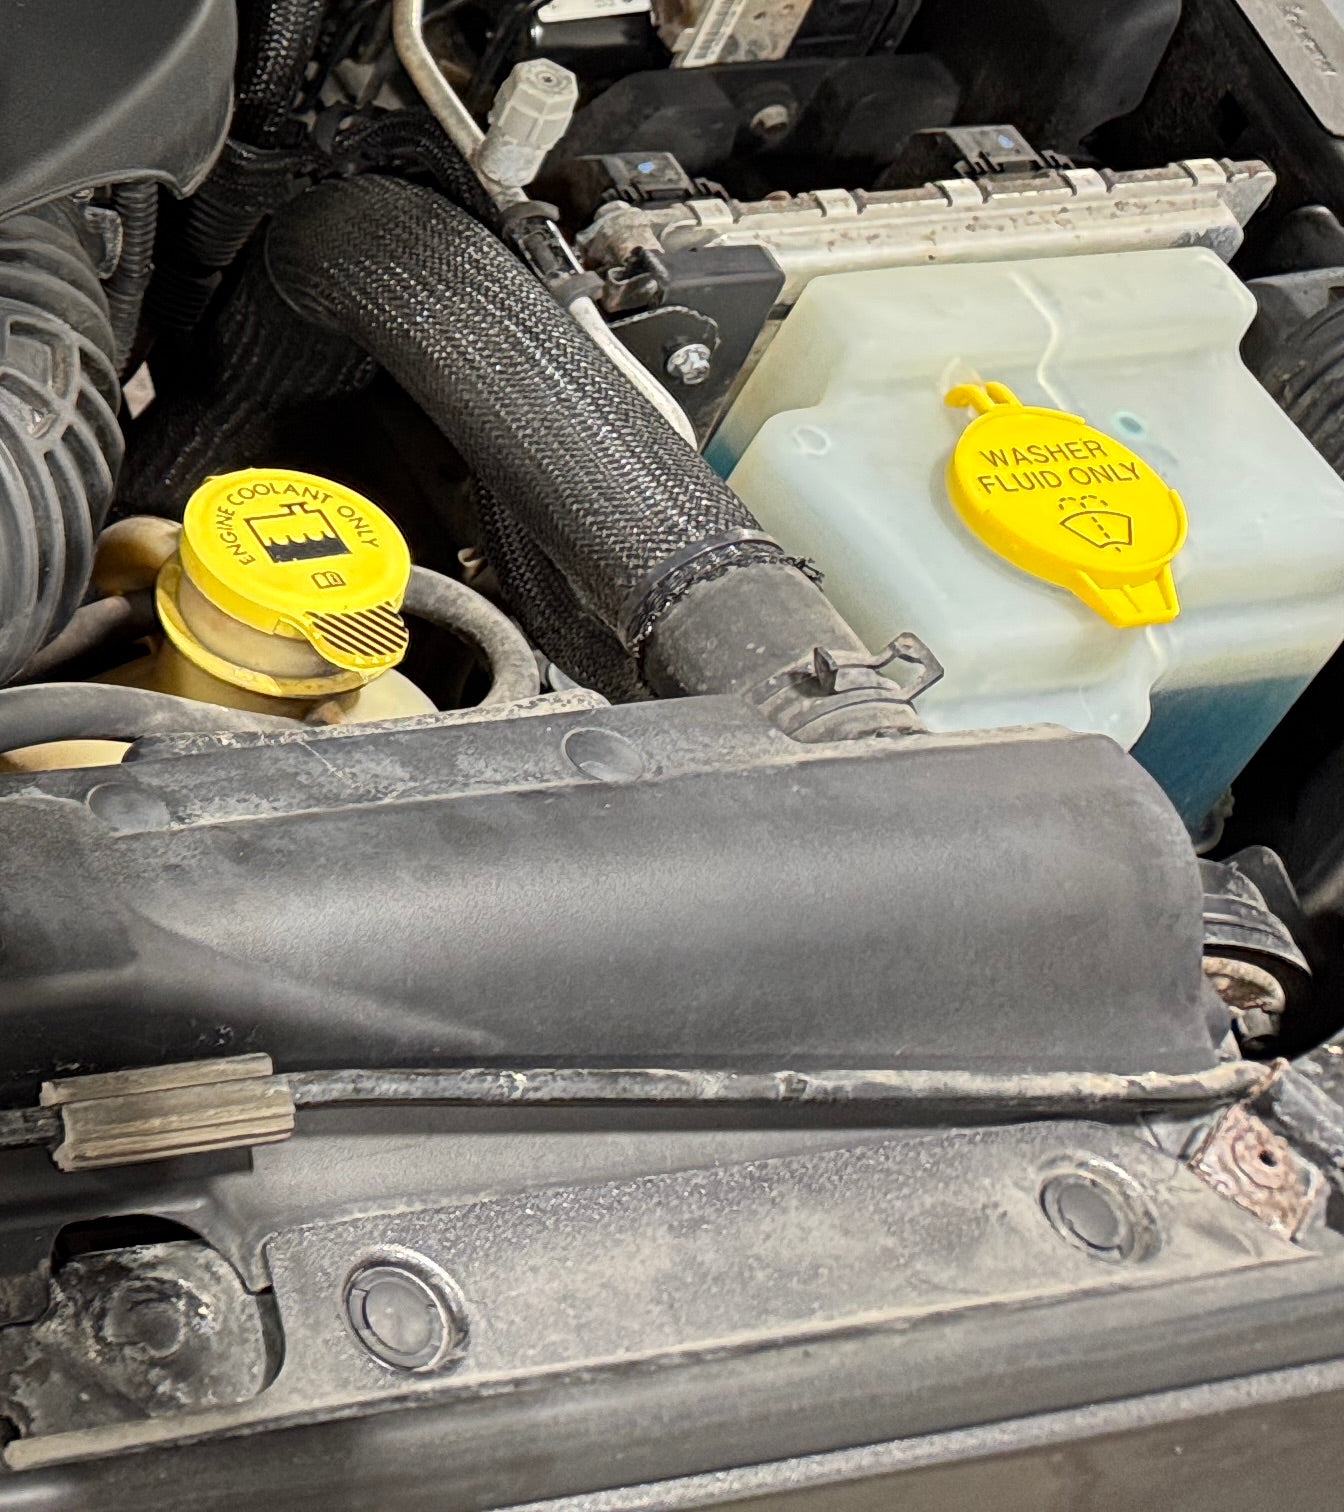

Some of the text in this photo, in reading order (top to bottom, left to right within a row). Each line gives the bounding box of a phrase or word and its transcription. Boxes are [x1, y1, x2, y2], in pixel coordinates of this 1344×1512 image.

[979, 439, 1108, 468] WASHER
[977, 462, 1140, 495] FLUID ONLY
[215, 482, 380, 566] ENGINE COOLANT ONLY
